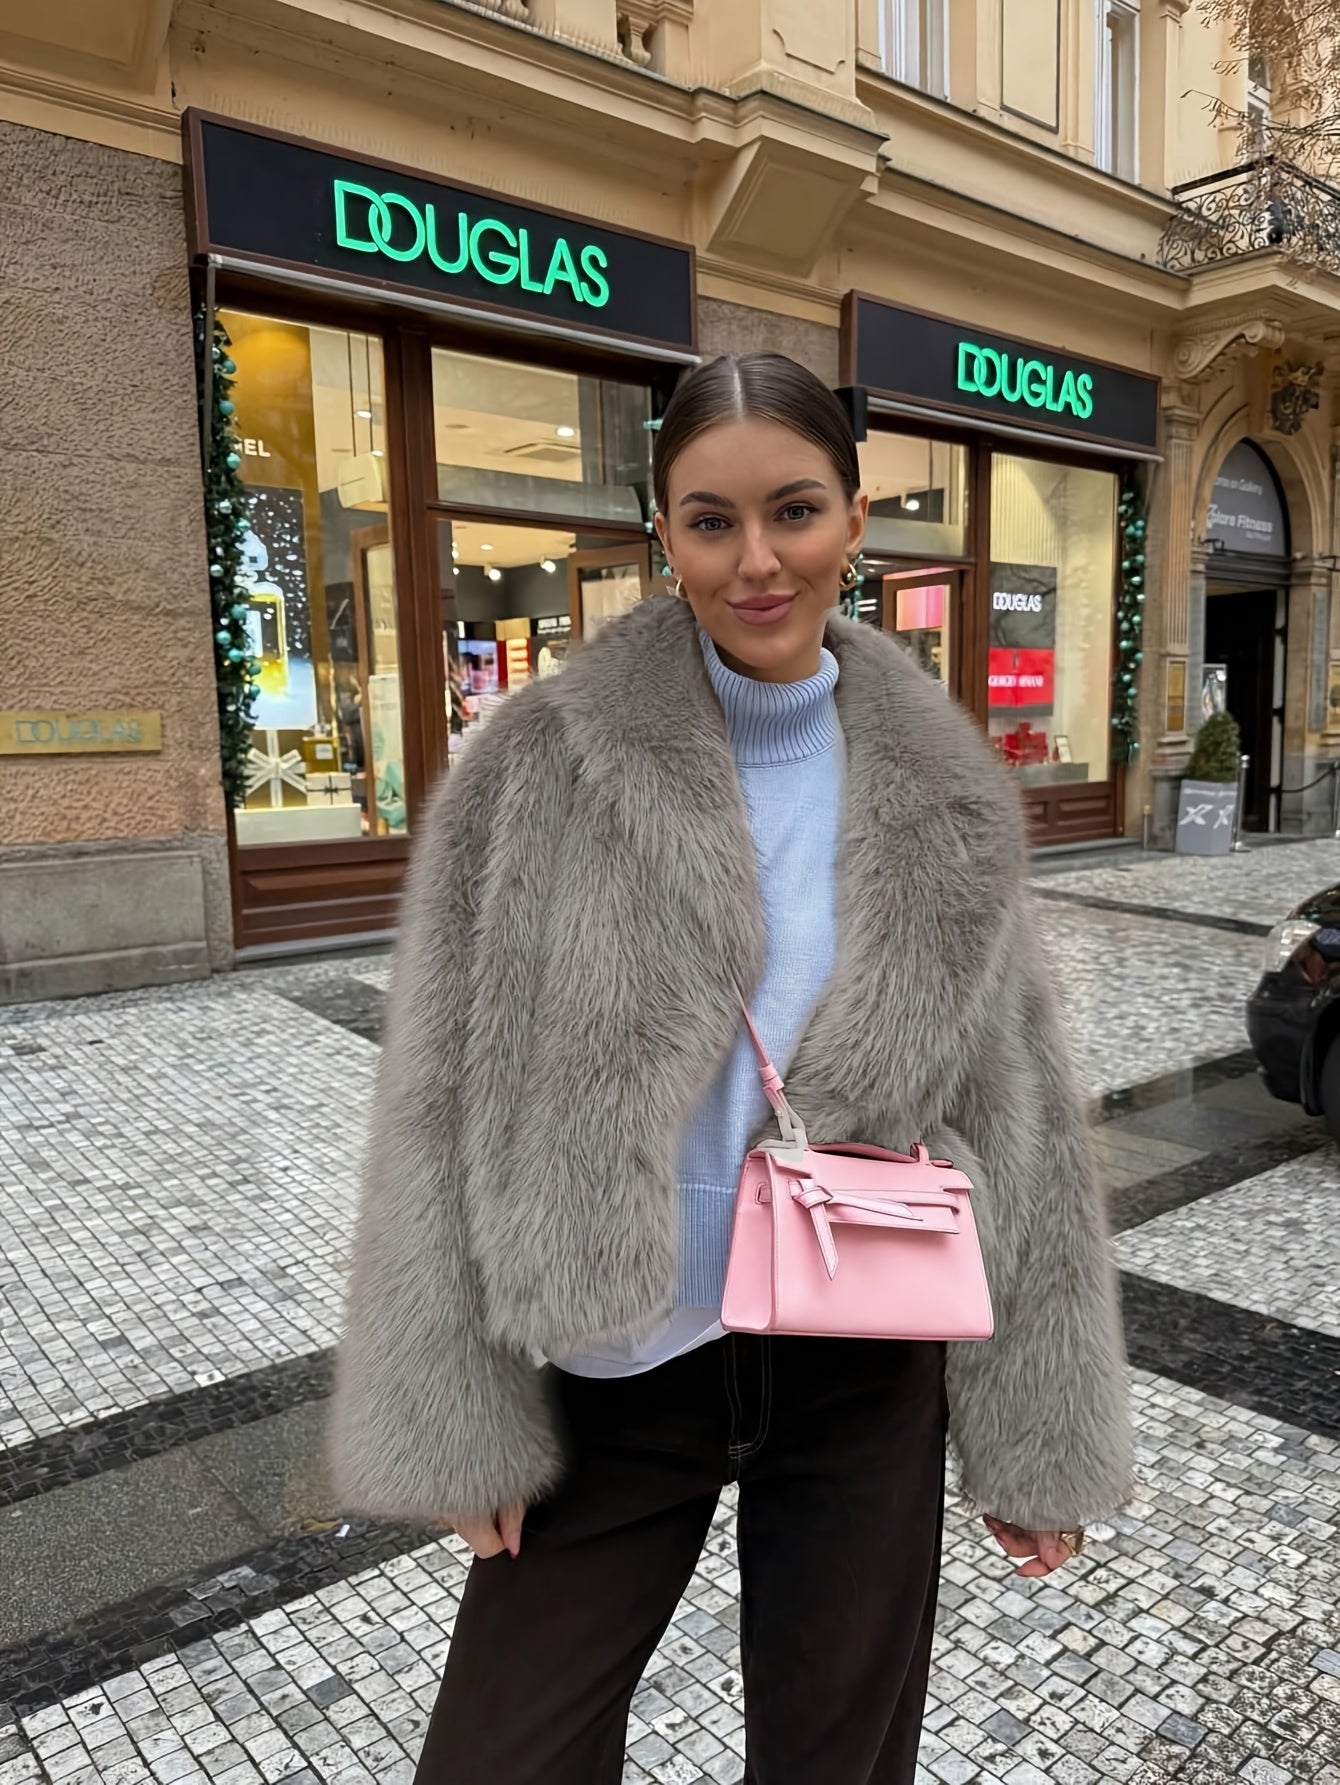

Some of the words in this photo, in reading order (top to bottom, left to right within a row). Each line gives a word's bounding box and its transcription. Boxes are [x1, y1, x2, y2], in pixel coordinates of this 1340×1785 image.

[334, 179, 609, 307] DOUGLAS
[958, 341, 1092, 418] DOUGLAS
[993, 592, 1042, 612] DOUGLAS
[15, 719, 142, 744] DOUGLAS
